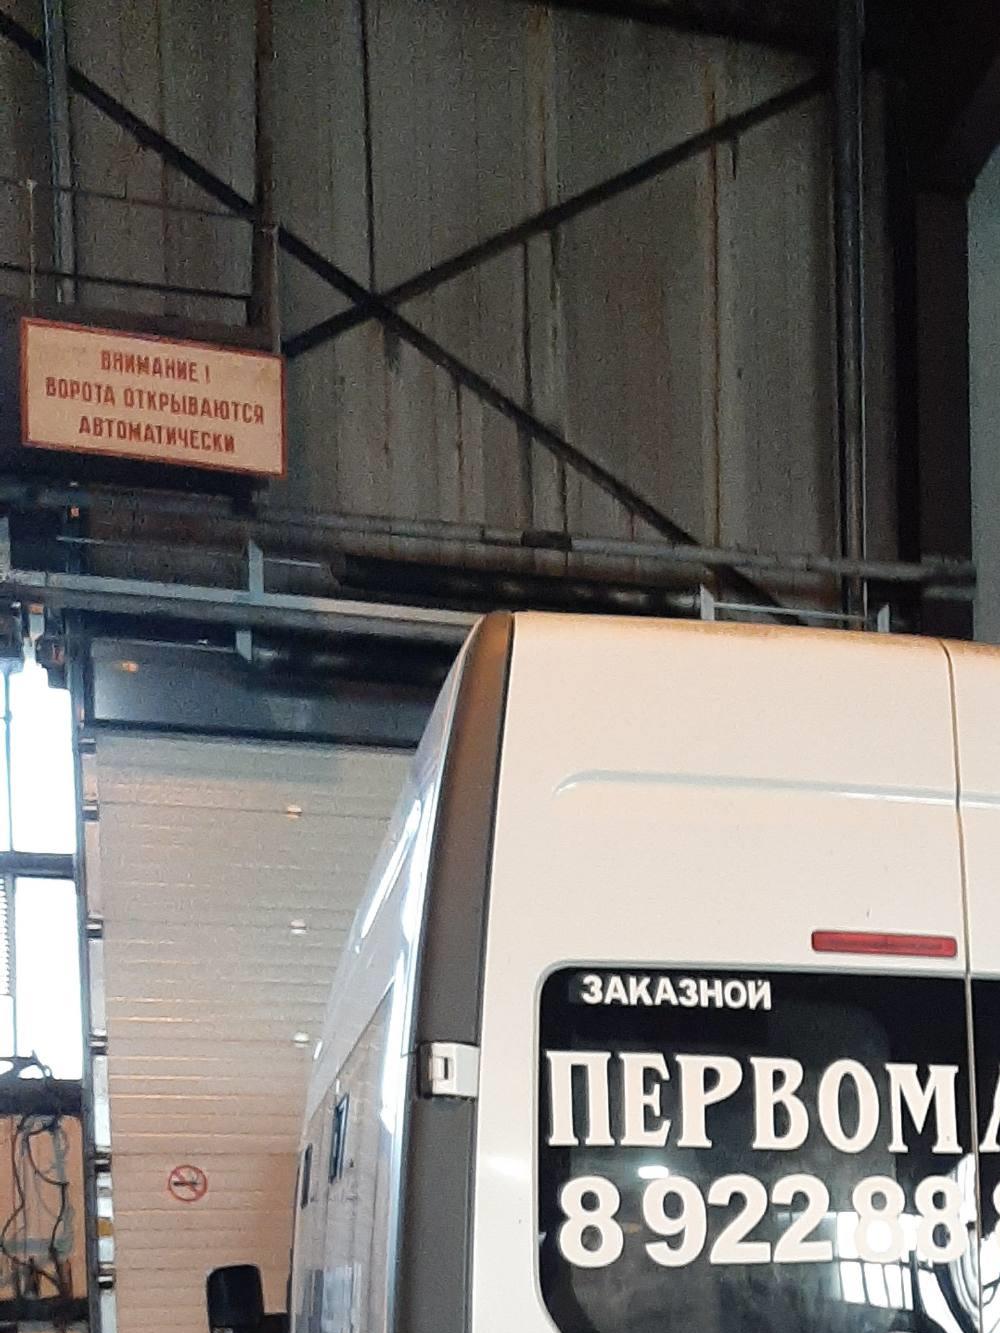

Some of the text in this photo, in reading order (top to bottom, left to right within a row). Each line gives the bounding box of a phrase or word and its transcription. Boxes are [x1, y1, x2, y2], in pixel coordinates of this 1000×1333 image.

[45, 376, 264, 425] ВОРОТА ОТКРЫВАЮТСЯ
[79, 415, 235, 453] АВТОМАТИЧЕСКИ
[581, 974, 772, 1010] ЗАКАЗНОЙ
